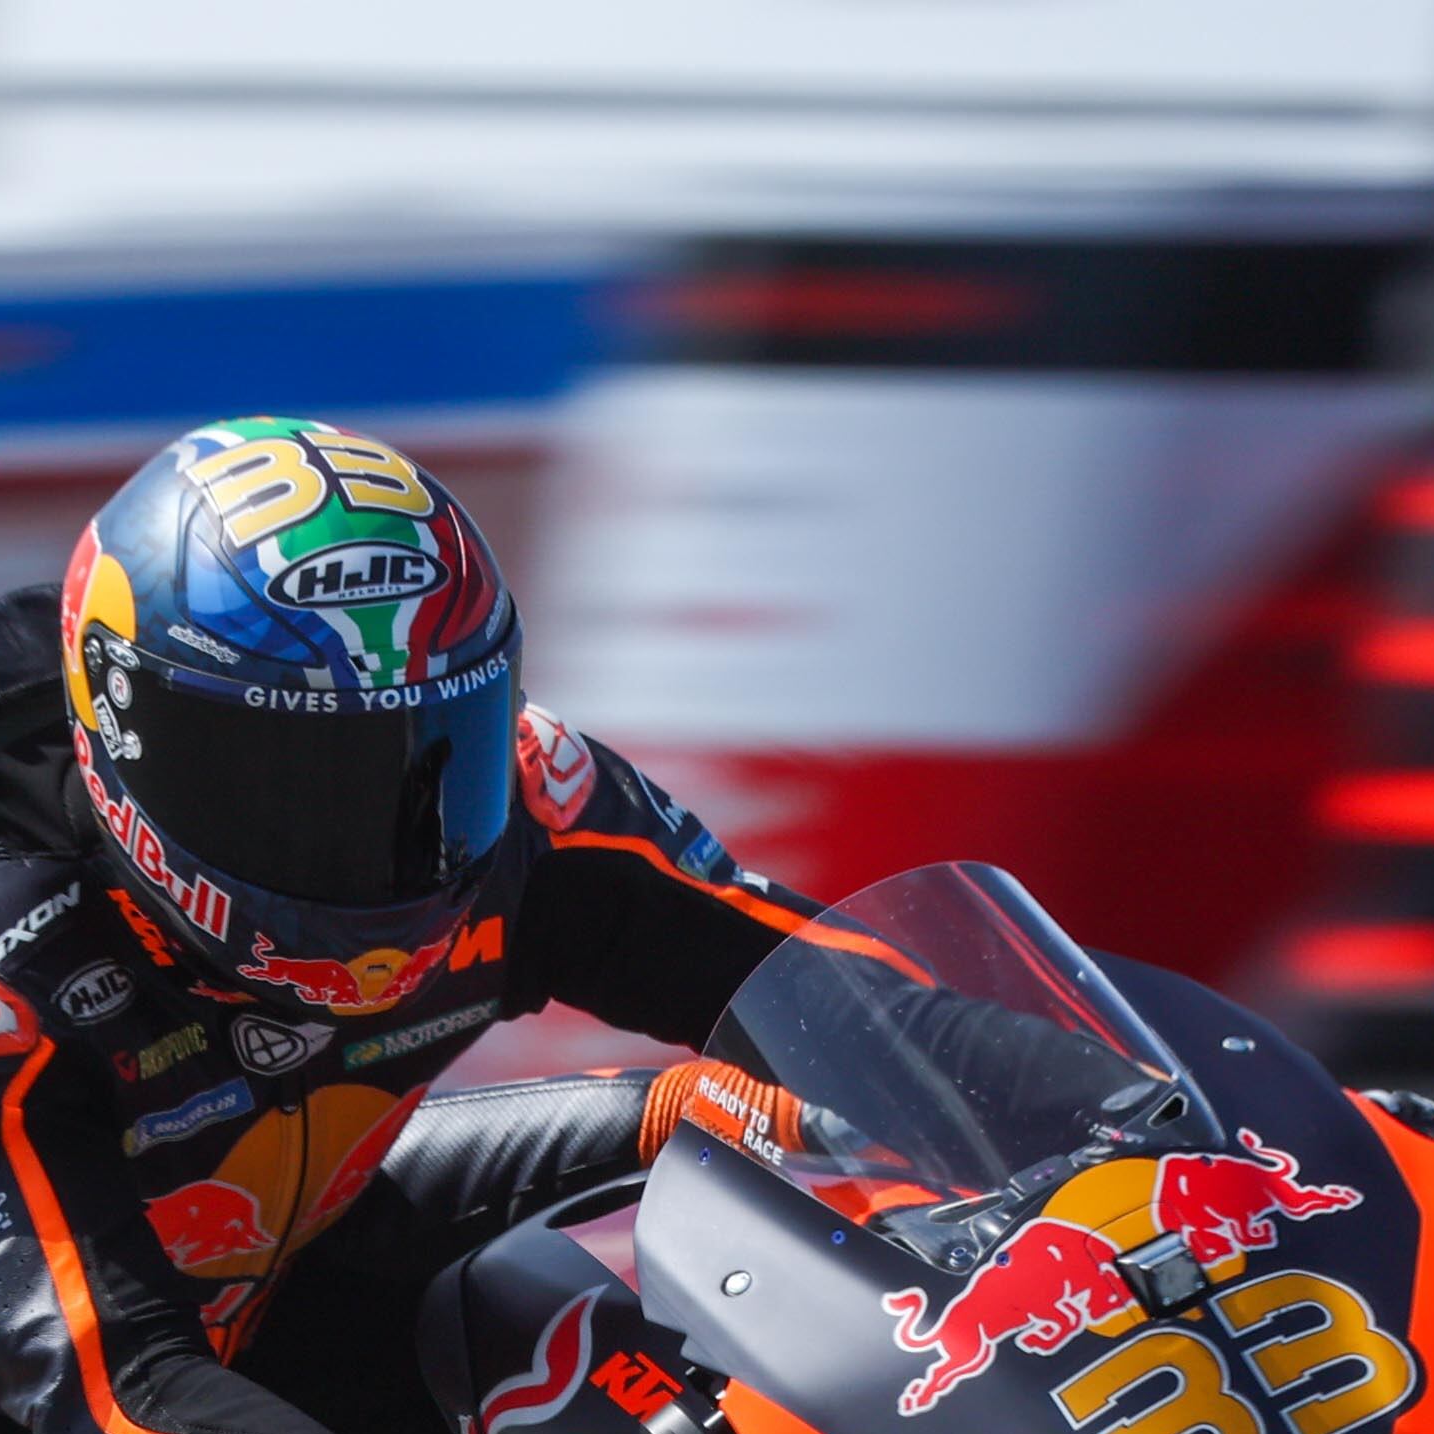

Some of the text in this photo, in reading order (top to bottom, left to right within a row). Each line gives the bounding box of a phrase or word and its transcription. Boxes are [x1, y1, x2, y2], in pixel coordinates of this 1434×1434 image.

[184, 430, 435, 548] 33
[296, 555, 425, 602] HJC
[244, 651, 509, 713] GIVES YOU WINGS
[69, 966, 129, 1016] HJC
[384, 1004, 495, 1057] MOTOREX
[699, 1076, 769, 1135] READY TO
[742, 1128, 784, 1167] RACE
